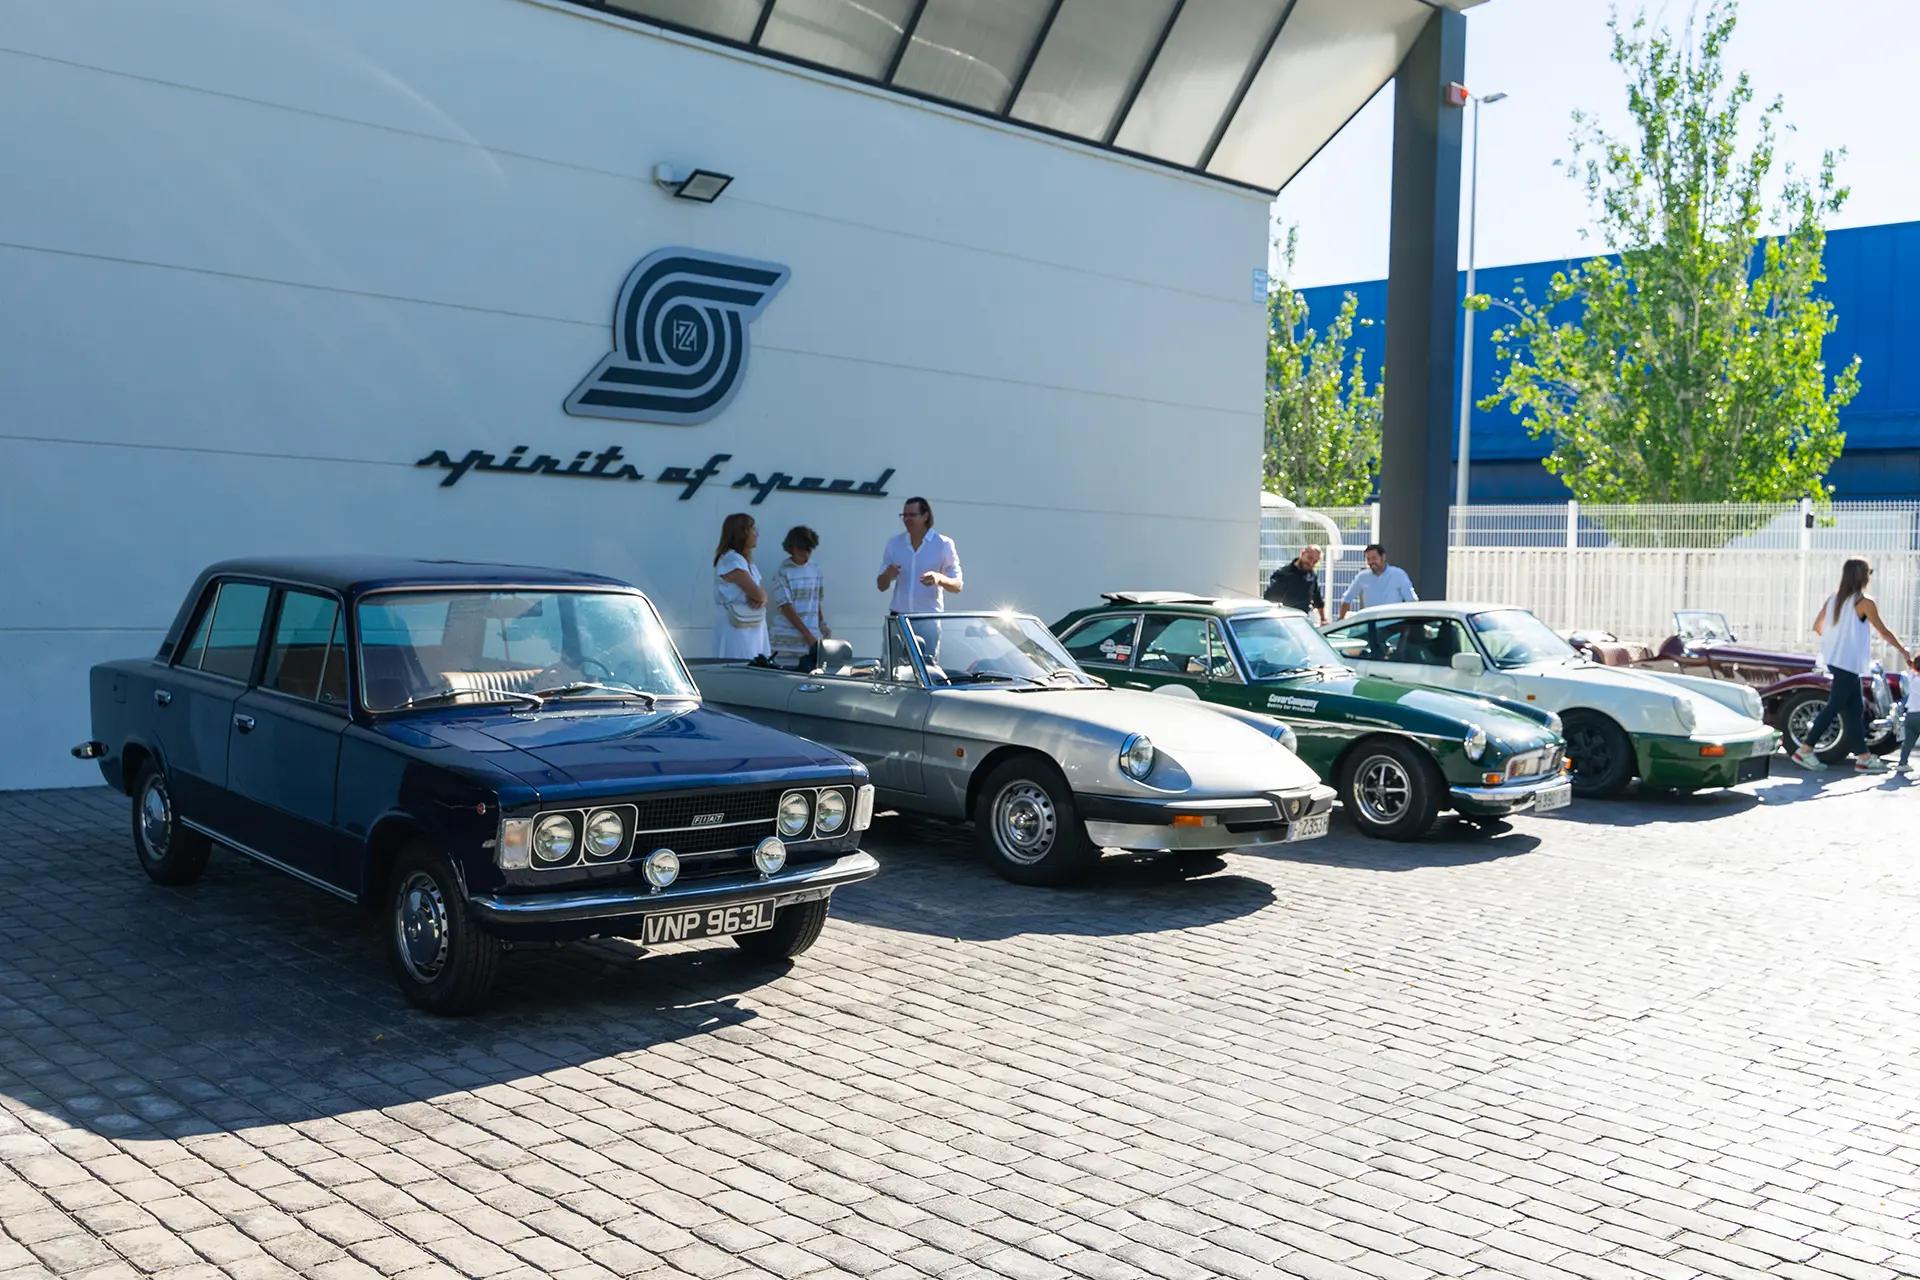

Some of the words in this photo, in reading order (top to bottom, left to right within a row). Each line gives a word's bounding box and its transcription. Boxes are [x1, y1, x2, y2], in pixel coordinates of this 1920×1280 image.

[416, 445, 644, 487] spirits
[657, 453, 732, 500] of
[732, 468, 896, 504] speed
[693, 814, 725, 825] FIAT
[647, 913, 700, 943] VNP
[706, 904, 773, 935] 963L
